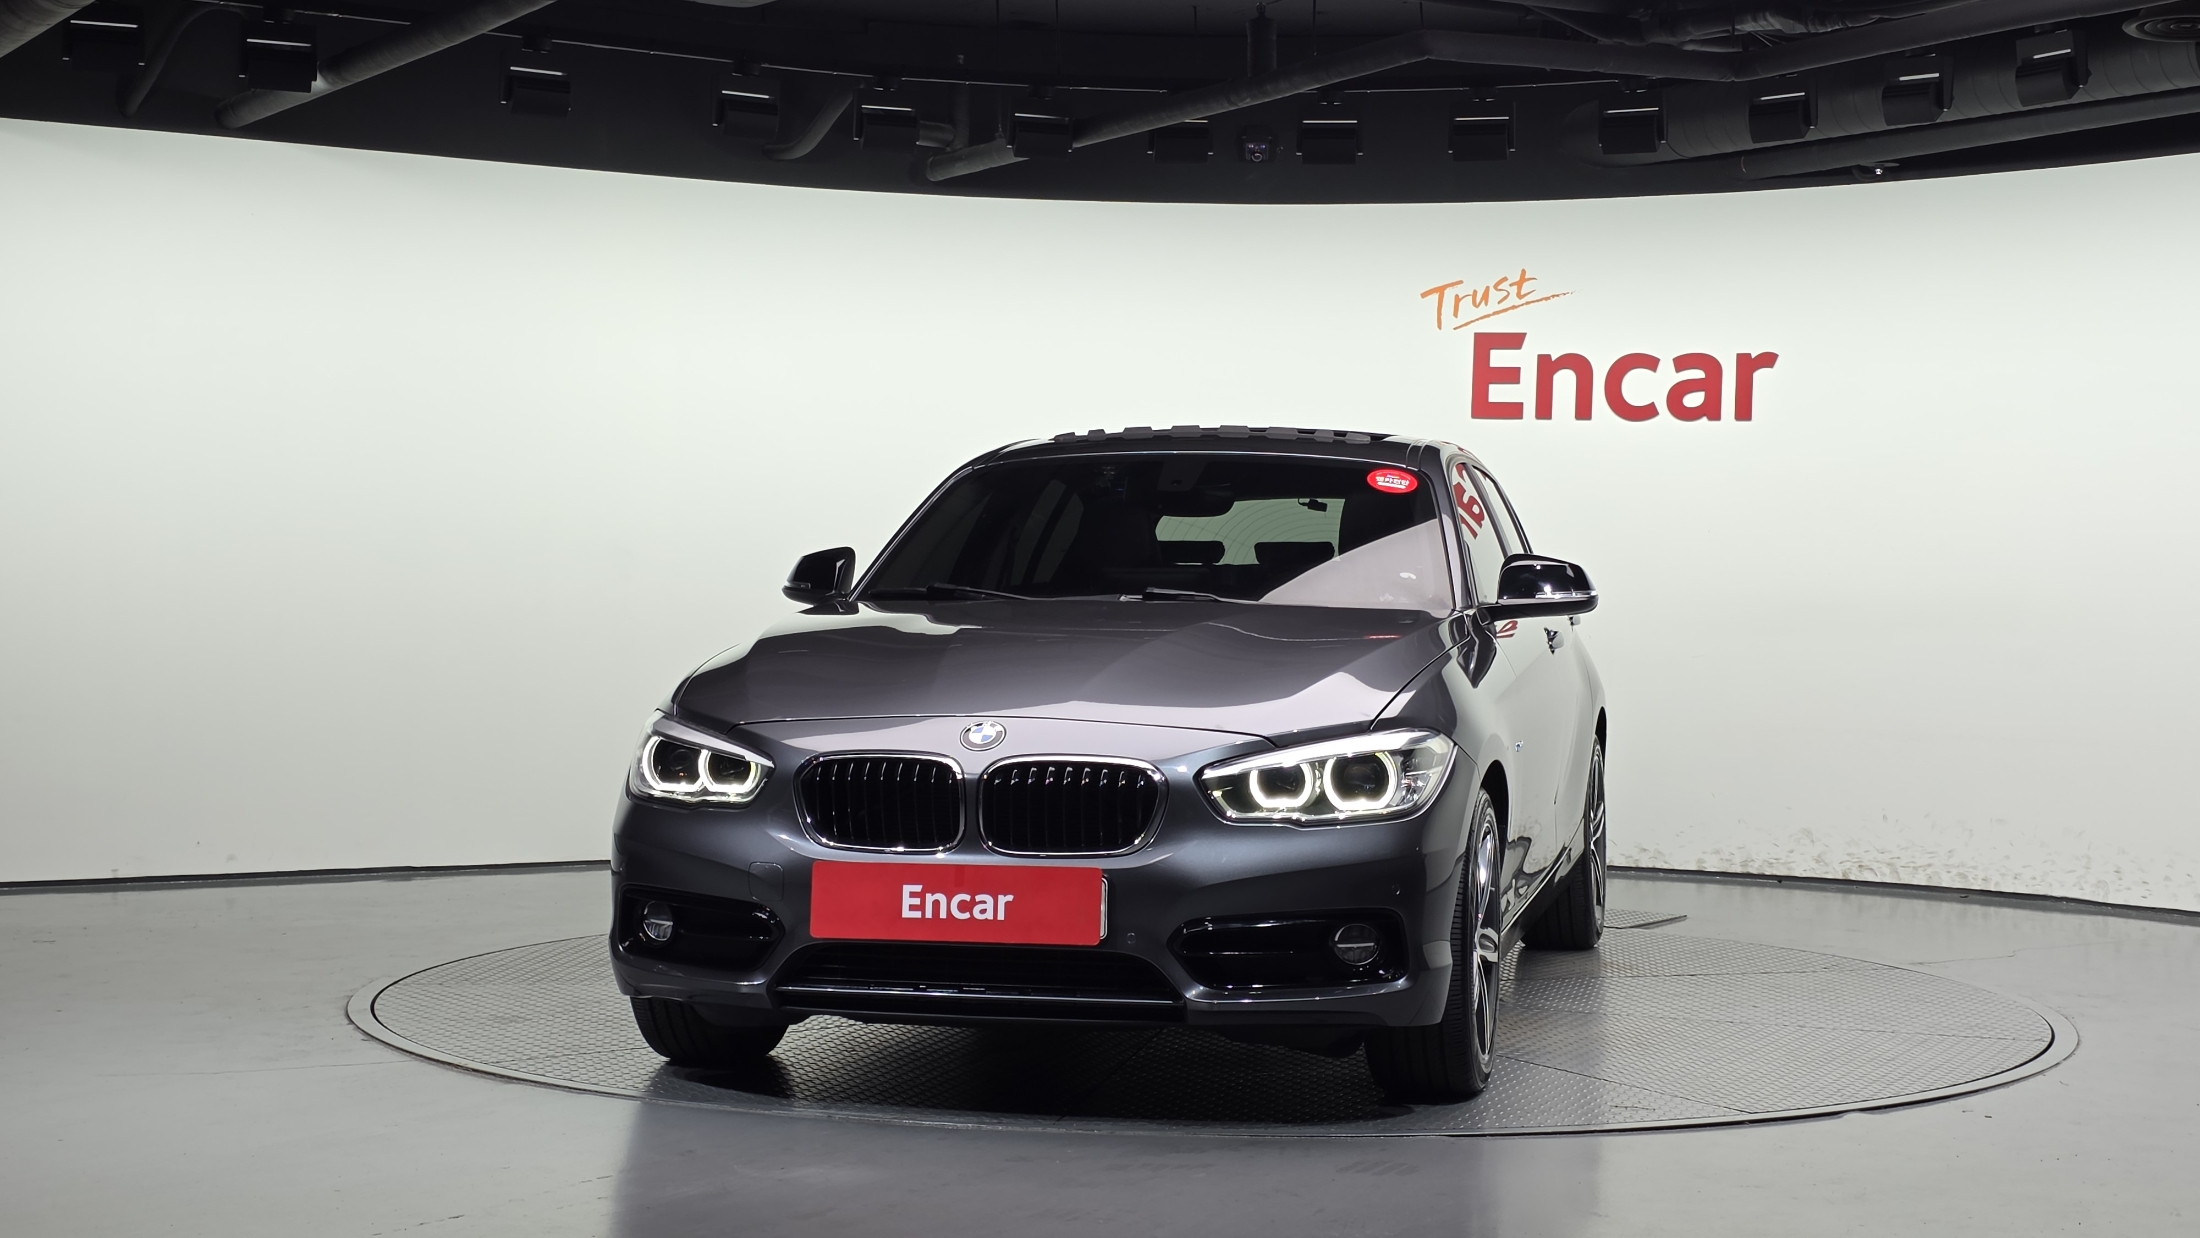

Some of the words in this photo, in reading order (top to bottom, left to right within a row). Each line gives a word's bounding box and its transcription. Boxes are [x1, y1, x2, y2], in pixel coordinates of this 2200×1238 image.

[1420, 268, 1538, 331] Trust
[1471, 332, 1778, 421] Encar
[901, 884, 1014, 921] Encar
